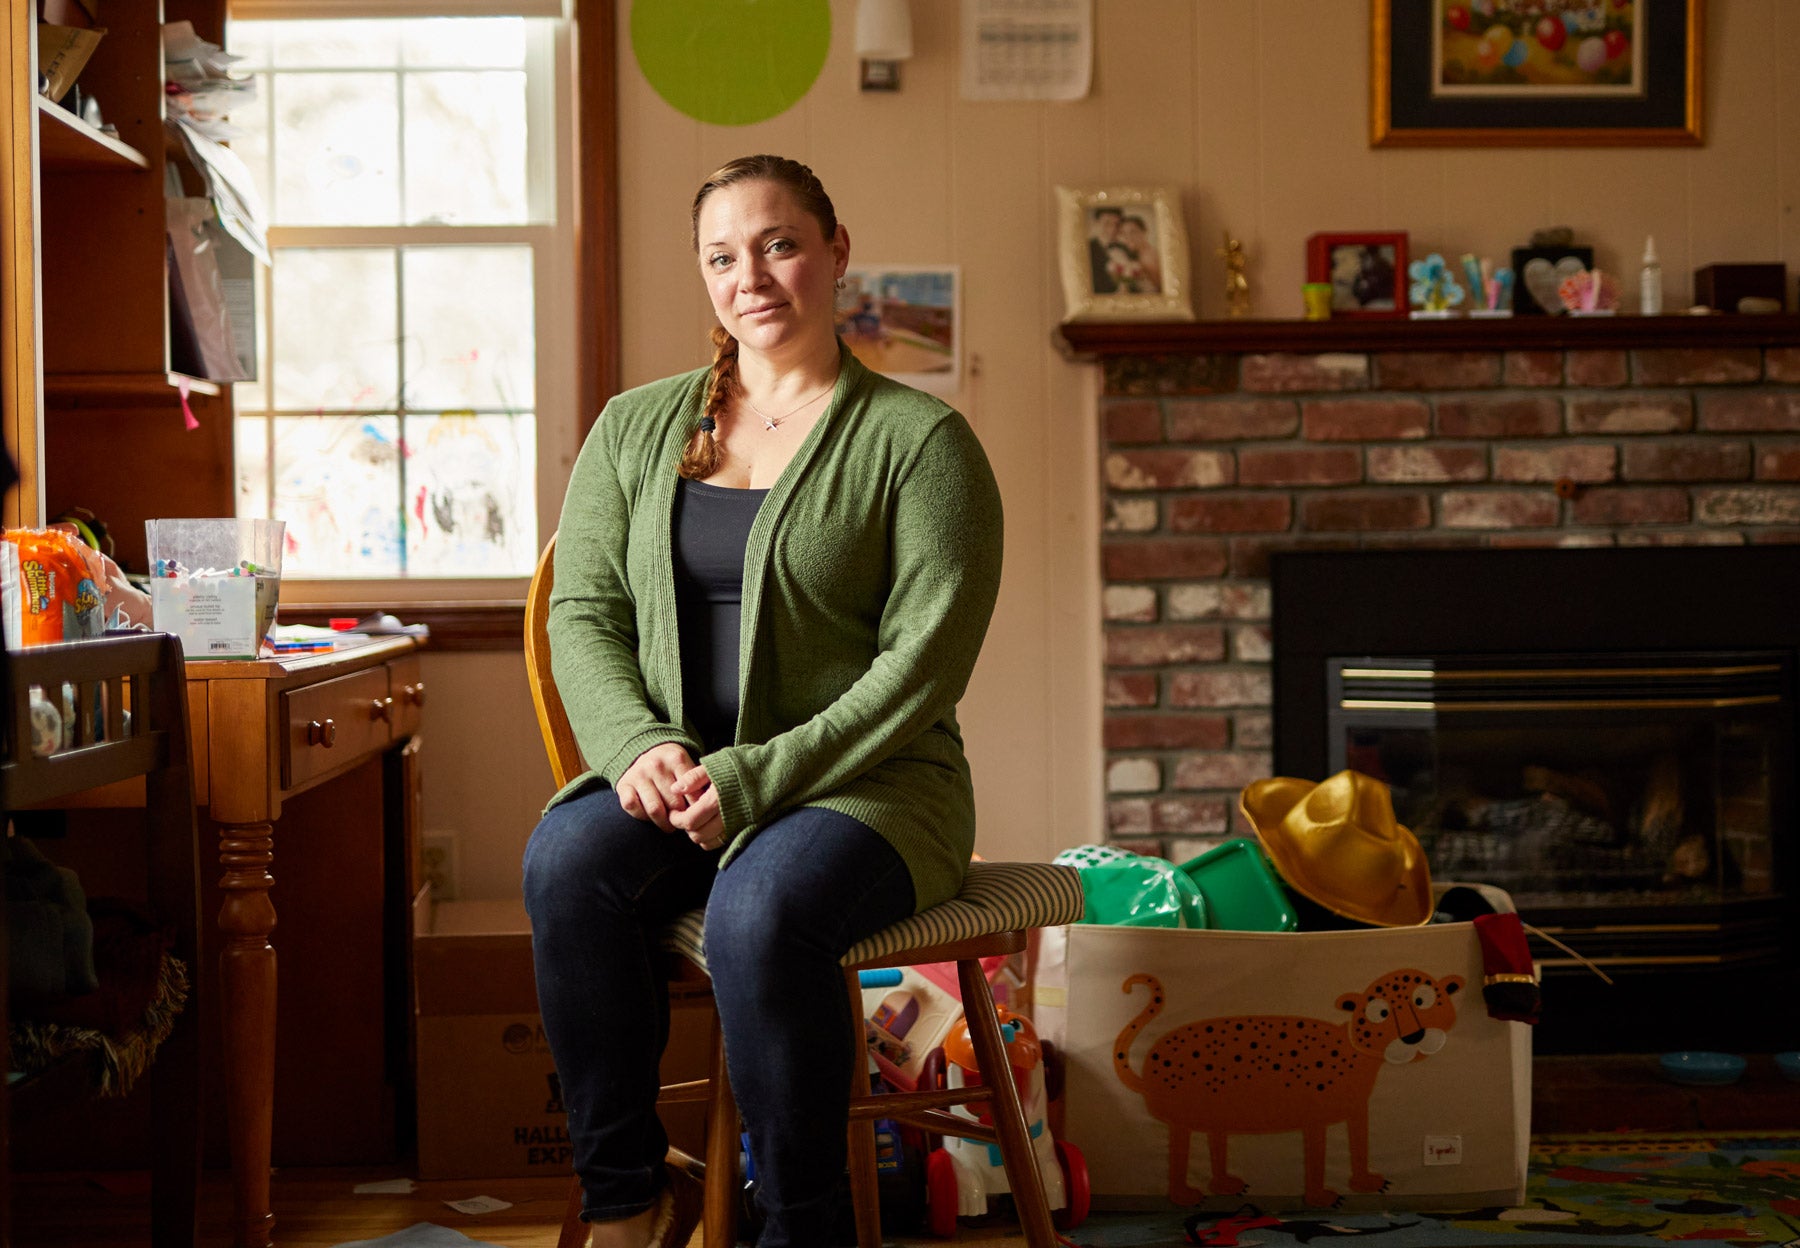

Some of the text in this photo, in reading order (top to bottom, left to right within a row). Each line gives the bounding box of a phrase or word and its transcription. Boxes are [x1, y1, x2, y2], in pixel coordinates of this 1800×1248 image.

[23, 560, 40, 614] Swimmers
[514, 1126, 571, 1145] HALL
[528, 1146, 574, 1165] EXP
